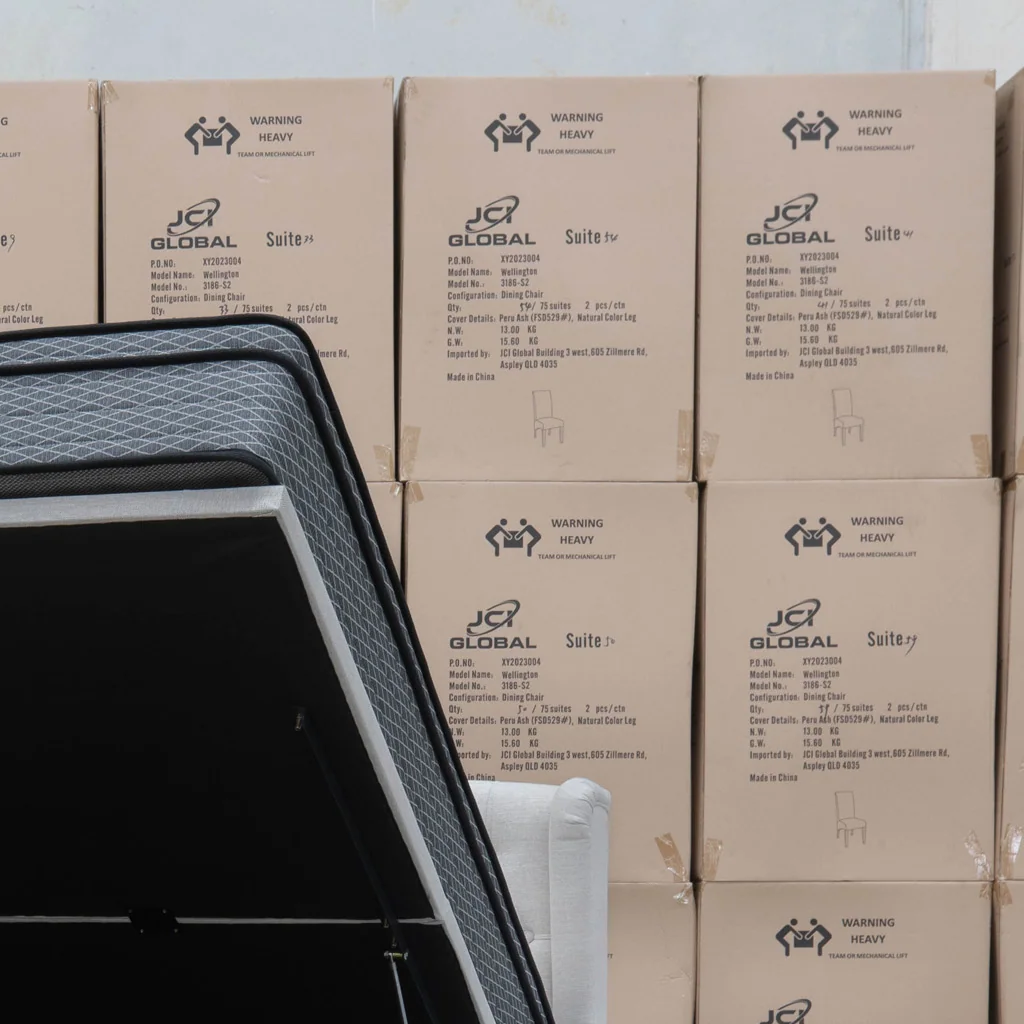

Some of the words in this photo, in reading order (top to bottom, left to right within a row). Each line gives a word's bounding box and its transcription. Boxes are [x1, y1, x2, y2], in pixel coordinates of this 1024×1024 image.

[551, 113, 604, 123] WARNING
[849, 109, 903, 119] WARNING
[250, 116, 303, 126] WARNING
[560, 130, 595, 139] HEAVY
[858, 127, 893, 136] HEAVY
[259, 133, 294, 142] HEAVY
[167, 205, 217, 232] JCI
[465, 202, 516, 229] JCI
[763, 200, 815, 227] JCI
[150, 236, 237, 250] GLOBAL
[448, 233, 536, 247] GLOBAL
[746, 231, 835, 245] GLOBAL
[203, 257, 242, 266] XY2023004
[800, 252, 840, 261] XY2023004
[501, 268, 538, 278] Wellington
[800, 266, 837, 276] Wellington
[501, 278, 530, 287] 3186-S2
[203, 293, 226, 303] Dining
[227, 292, 246, 301] Chair
[12, 315, 30, 324] Color
[31, 315, 43, 325] Leg
[500, 360, 523, 370] Aspley
[525, 359, 538, 369] QLD
[540, 359, 558, 368] 4035
[746, 372, 765, 381] Made
[766, 372, 773, 381] in
[775, 370, 794, 381] China
[551, 519, 604, 529] WARNING
[851, 516, 905, 526] WARNING
[560, 536, 594, 545] HEAVY
[860, 533, 895, 542] HEAVY
[466, 606, 517, 632] JCI
[766, 605, 817, 632] JCI
[449, 635, 537, 649] GLOBAL
[750, 635, 838, 649] GLOBAL
[502, 657, 541, 666] XY2023004
[802, 657, 842, 666] XY2023004
[803, 670, 840, 680] Wellington
[502, 693, 525, 703] Dining
[526, 693, 545, 702] Chair
[577, 716, 604, 725] Natural
[605, 716, 622, 725] Color
[624, 716, 636, 726] Leg
[750, 773, 768, 782] Made
[770, 773, 777, 782] in
[778, 772, 797, 782] China
[842, 918, 896, 928] WARNING
[851, 935, 886, 944] HEAVY
